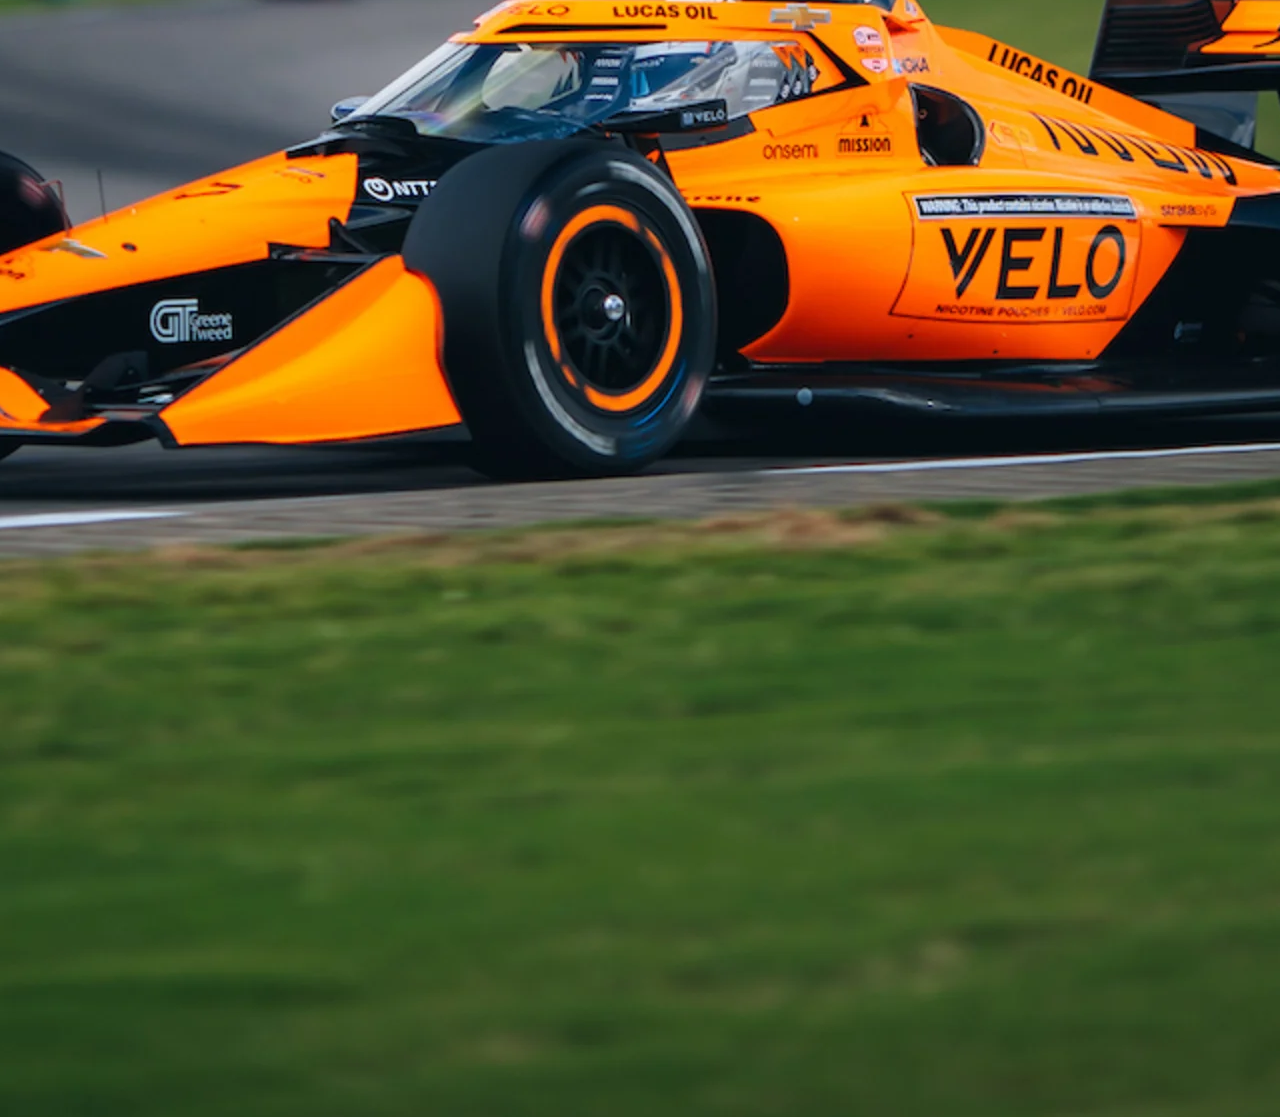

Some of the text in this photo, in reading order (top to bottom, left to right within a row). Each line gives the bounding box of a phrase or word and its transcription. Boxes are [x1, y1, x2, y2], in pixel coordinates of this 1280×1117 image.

[613, 4, 718, 20] LUCAS OIL
[694, 110, 725, 123] VELO
[762, 144, 819, 160] onsemi
[940, 225, 1127, 300] VELO
[935, 304, 1108, 318] NICOTINE POUCHES VELO.COM
[189, 313, 232, 327] Greene
[191, 324, 232, 341] Tweed
